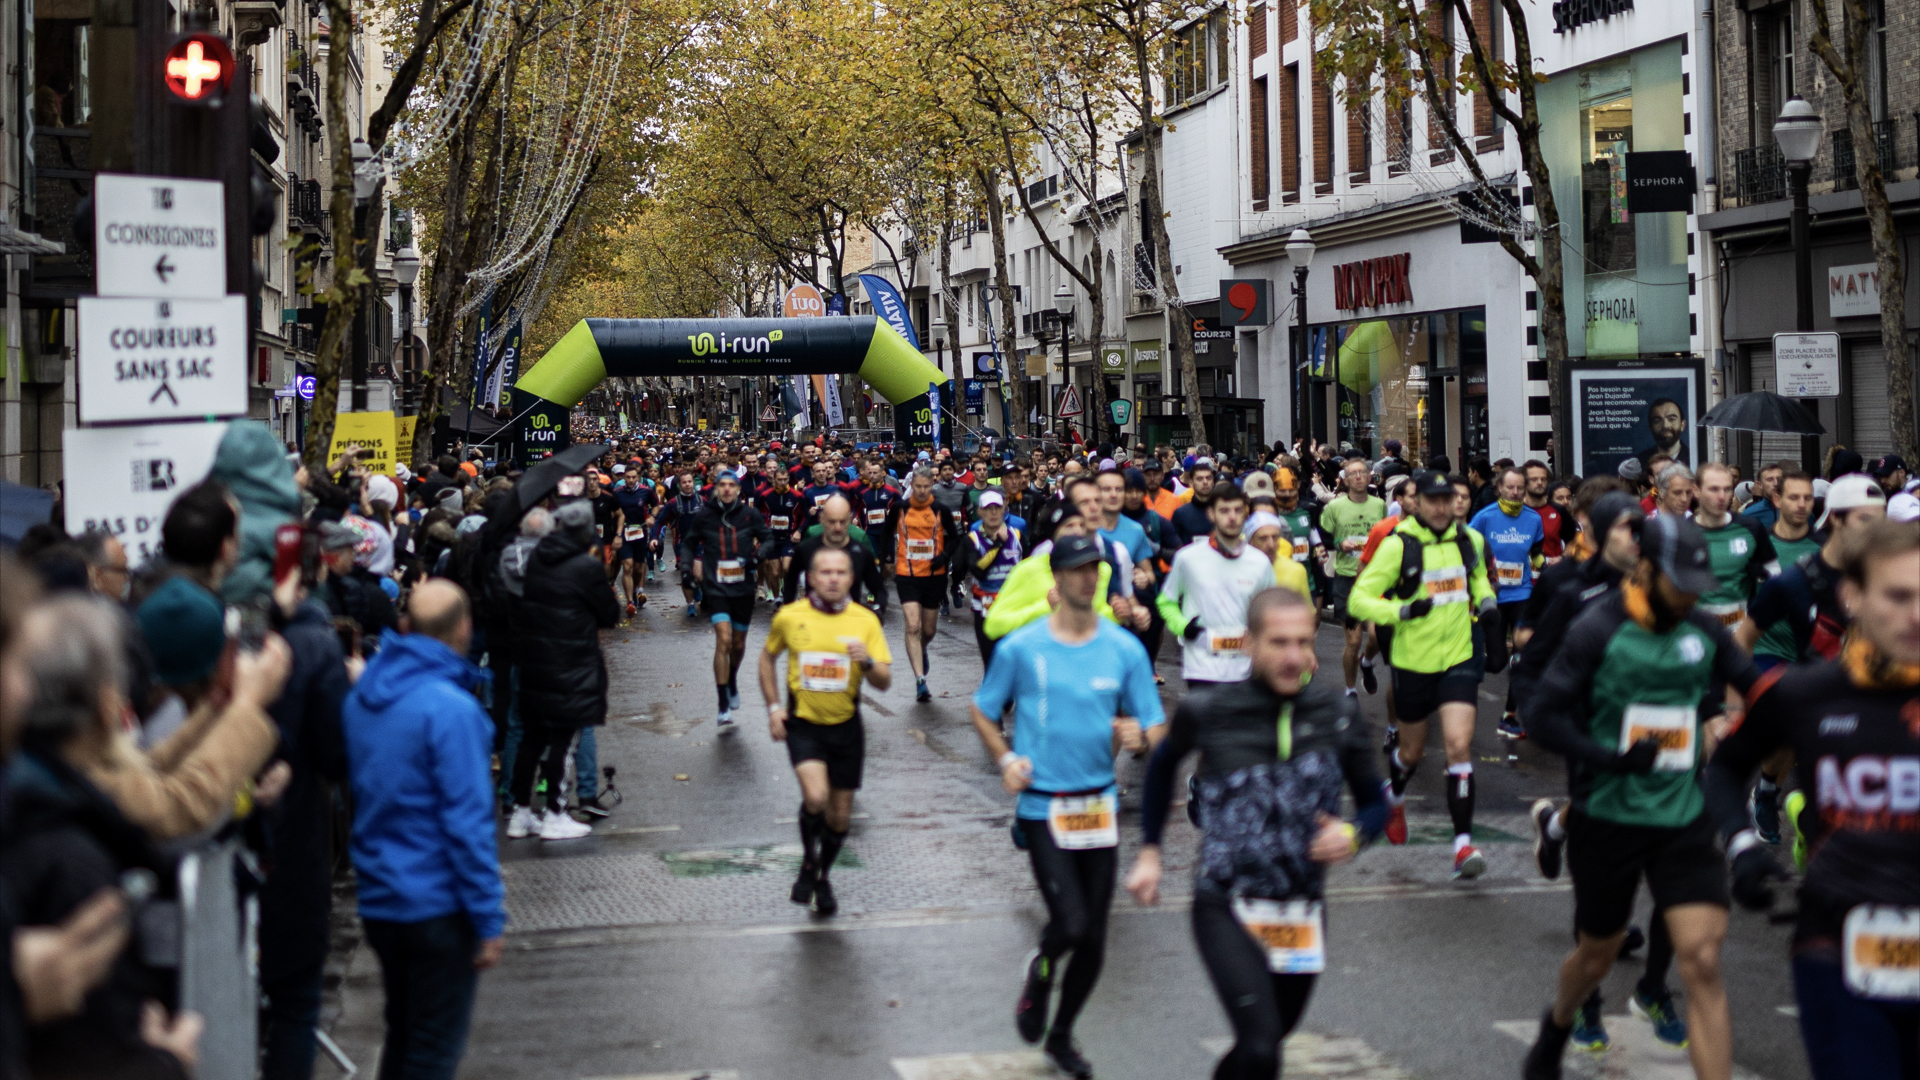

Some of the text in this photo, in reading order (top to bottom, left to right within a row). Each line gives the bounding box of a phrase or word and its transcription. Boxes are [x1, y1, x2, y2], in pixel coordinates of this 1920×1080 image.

[1633, 176, 1684, 187] SEPHORA
[105, 222, 217, 248] CONSIGNES
[1332, 252, 1413, 311] MONOPRIX
[1830, 271, 1880, 297] MATY
[1587, 298, 1635, 322] SEPHORA
[110, 326, 217, 349] COUREURS
[720, 332, 770, 353] i-run
[1194, 330, 1232, 339] COURIR
[115, 357, 213, 381] SANS SAC
[524, 427, 556, 441] i-run
[909, 422, 931, 436] i-ru
[377, 451, 388, 460] LE
